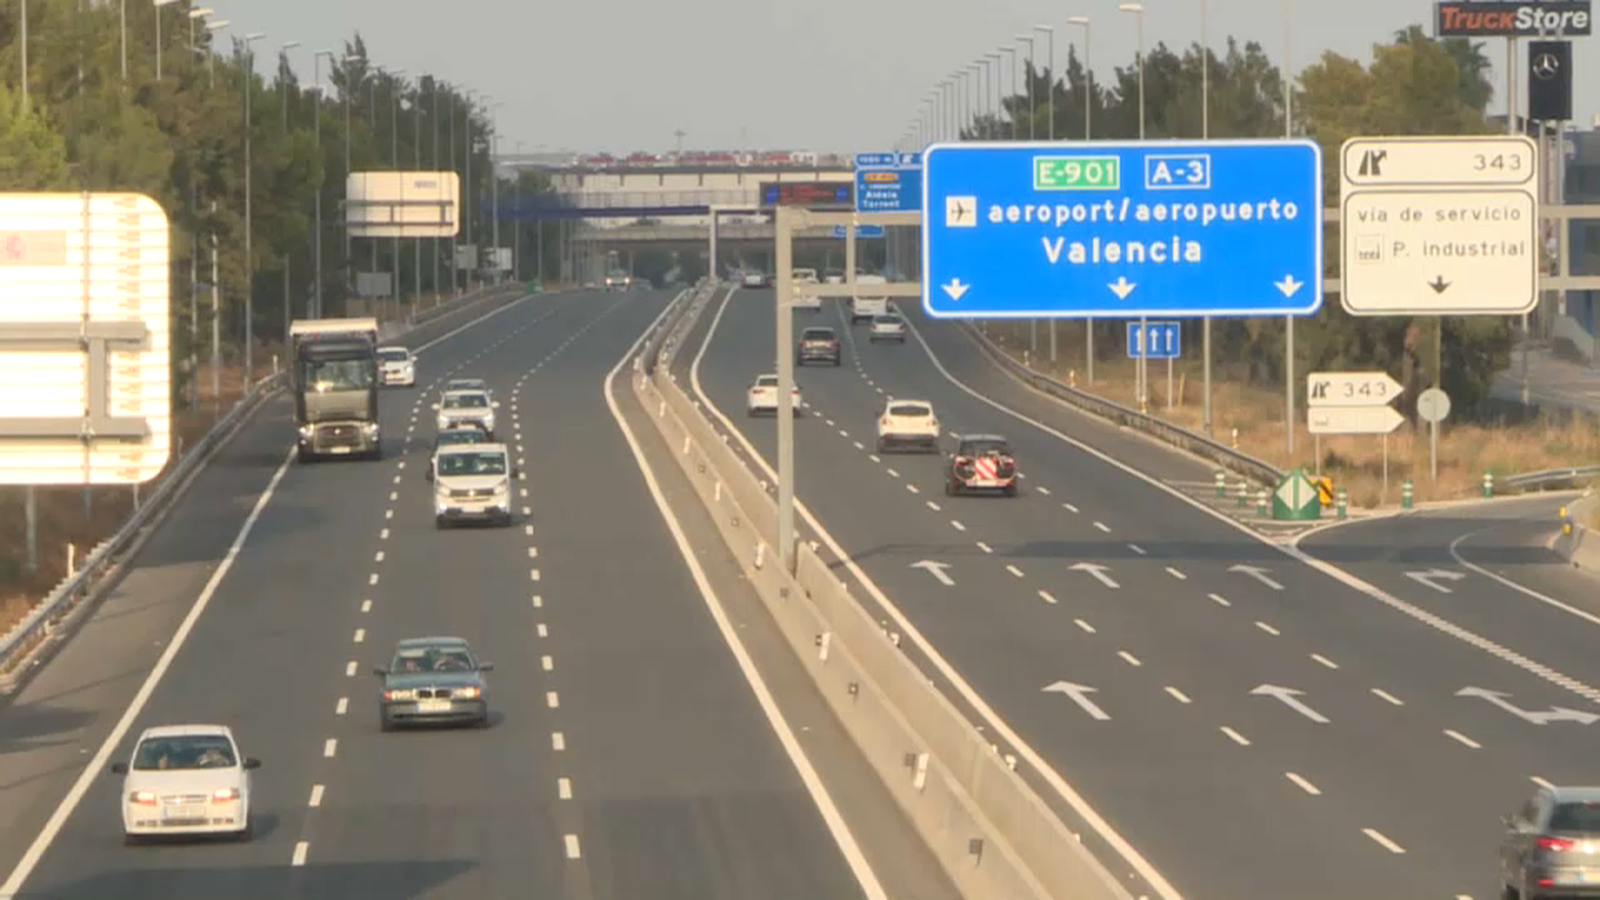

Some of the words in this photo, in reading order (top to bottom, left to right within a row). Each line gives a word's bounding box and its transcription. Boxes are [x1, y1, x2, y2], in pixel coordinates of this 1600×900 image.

[1440, 6, 1588, 31] TruckStore
[1038, 160, 1116, 185] E-901
[1151, 159, 1205, 184] A-3
[1473, 153, 1522, 171] 343
[987, 196, 1299, 228] aeroport/aeropuerto
[1400, 206, 1424, 222] de
[1434, 205, 1522, 222] servicio
[1041, 234, 1203, 265] Valencia
[1393, 240, 1411, 258] P.
[1422, 239, 1526, 258] industrial
[1343, 381, 1388, 398] 343
